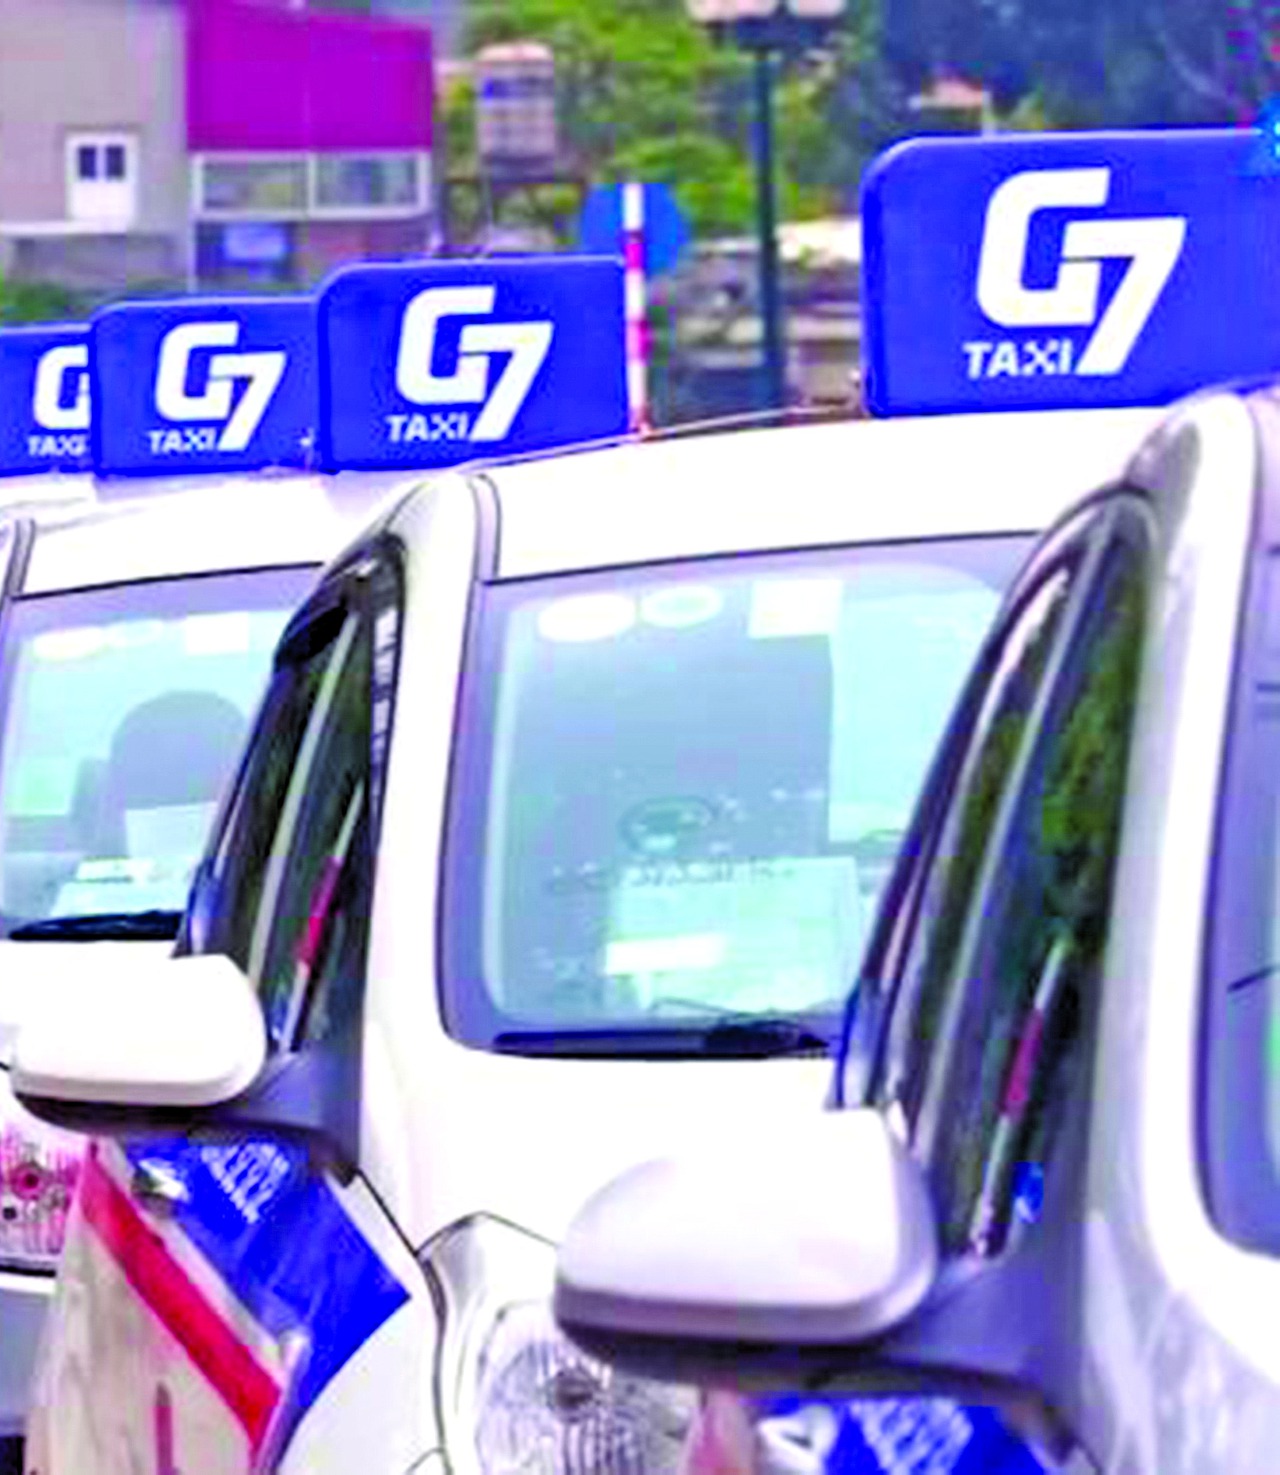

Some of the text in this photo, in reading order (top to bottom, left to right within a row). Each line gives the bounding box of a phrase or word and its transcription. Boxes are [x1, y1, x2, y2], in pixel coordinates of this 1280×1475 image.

[977, 167, 1187, 375] G7
[33, 343, 91, 430] G
[156, 321, 286, 451] G7
[396, 286, 553, 442] G7
[963, 339, 1073, 378] TAXI
[150, 426, 217, 455] TAXI
[386, 412, 469, 442] TAXI
